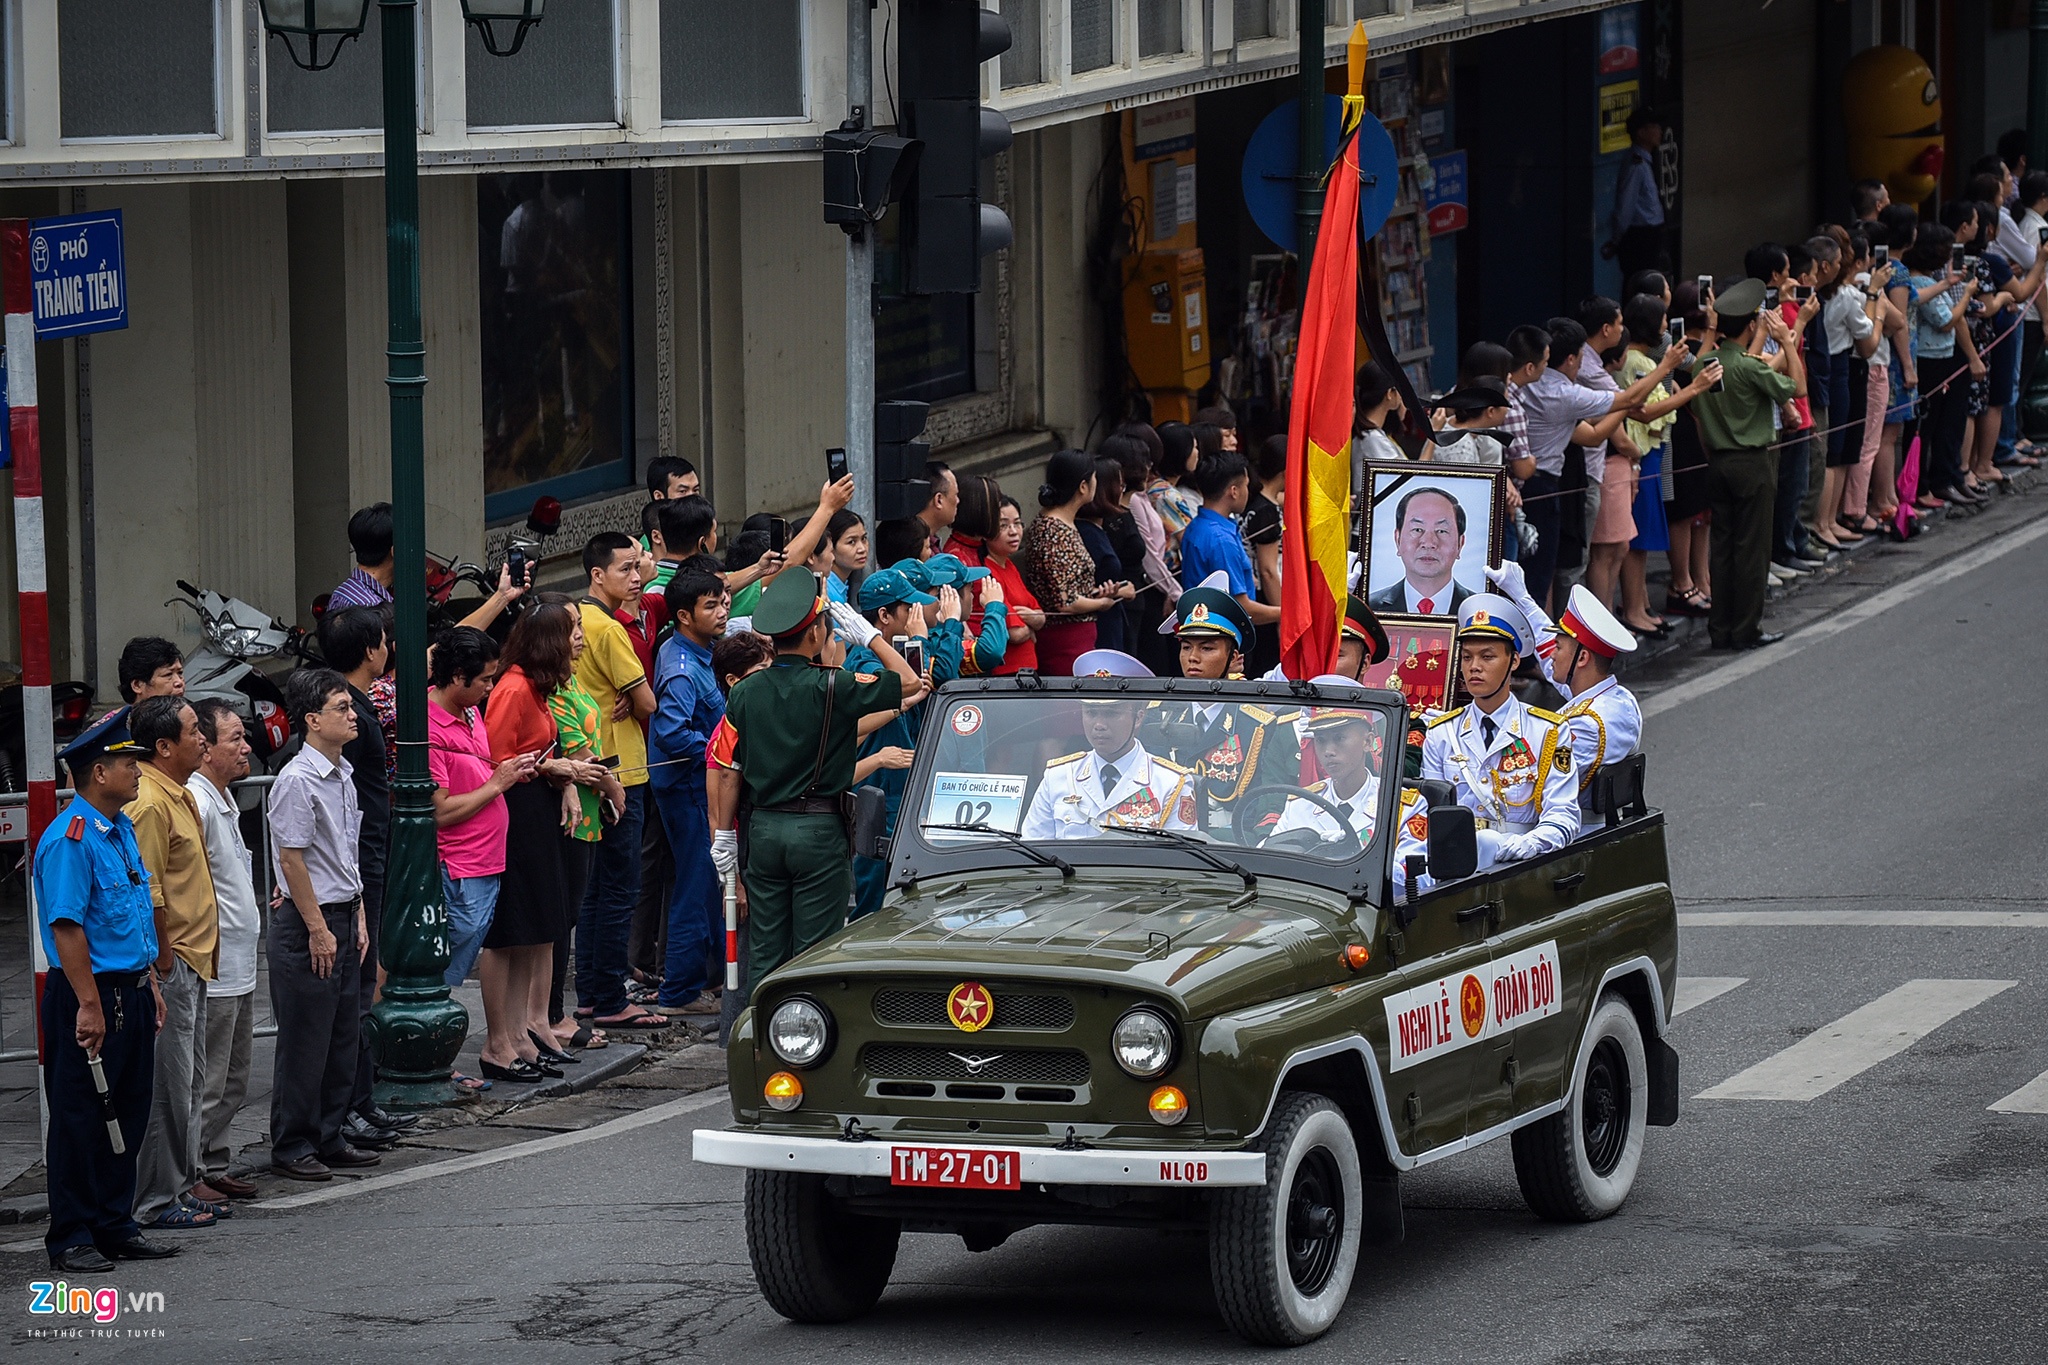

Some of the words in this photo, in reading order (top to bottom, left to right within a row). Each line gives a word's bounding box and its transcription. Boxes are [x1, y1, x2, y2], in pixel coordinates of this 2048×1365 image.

[59, 228, 88, 261] PHỐ
[35, 269, 84, 319] TRÀNG
[86, 259, 119, 311] TIỀN
[962, 710, 972, 722] 9
[941, 782, 956, 791] BAN
[958, 779, 969, 791] TỔ
[969, 781, 989, 792] CHỨC
[1001, 784, 1020, 793] TANG
[955, 800, 992, 825] 02
[1397, 1004, 1432, 1059] NGHI
[1434, 981, 1452, 1045] LỄ
[1493, 964, 1529, 1028] QUÂN
[1530, 953, 1555, 1016] ĐỘI
[895, 1150, 1011, 1185] TM-27-01
[1160, 1161, 1208, 1183] NLQĐ
